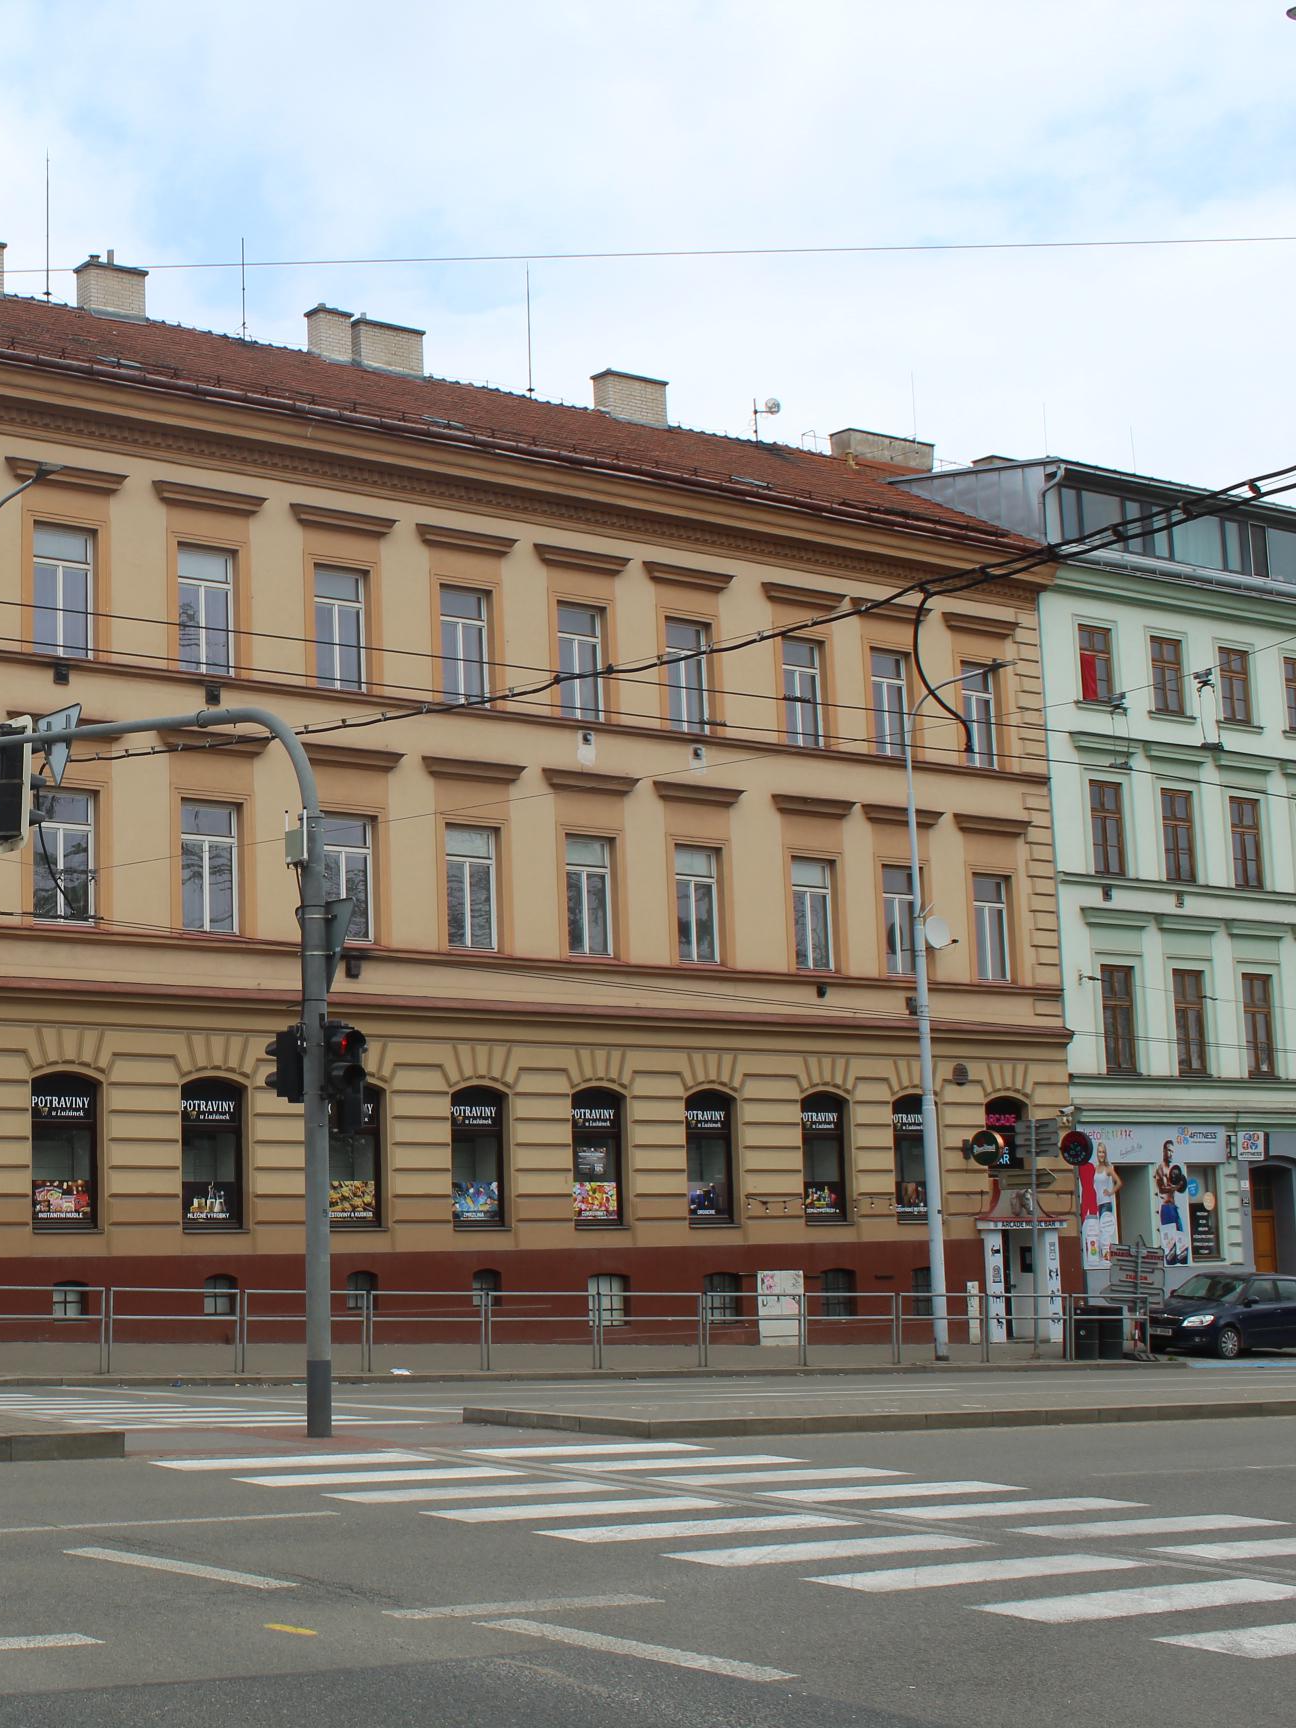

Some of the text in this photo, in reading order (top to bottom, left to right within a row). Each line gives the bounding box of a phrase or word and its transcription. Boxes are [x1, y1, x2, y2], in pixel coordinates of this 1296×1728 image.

[32, 1096, 90, 1109] POTRAVINY
[181, 1100, 235, 1112] POTRAVINY
[58, 1108, 85, 1117] Lužánek
[892, 1113, 923, 1123] OTRAVIN
[997, 1153, 1010, 1164] AR
